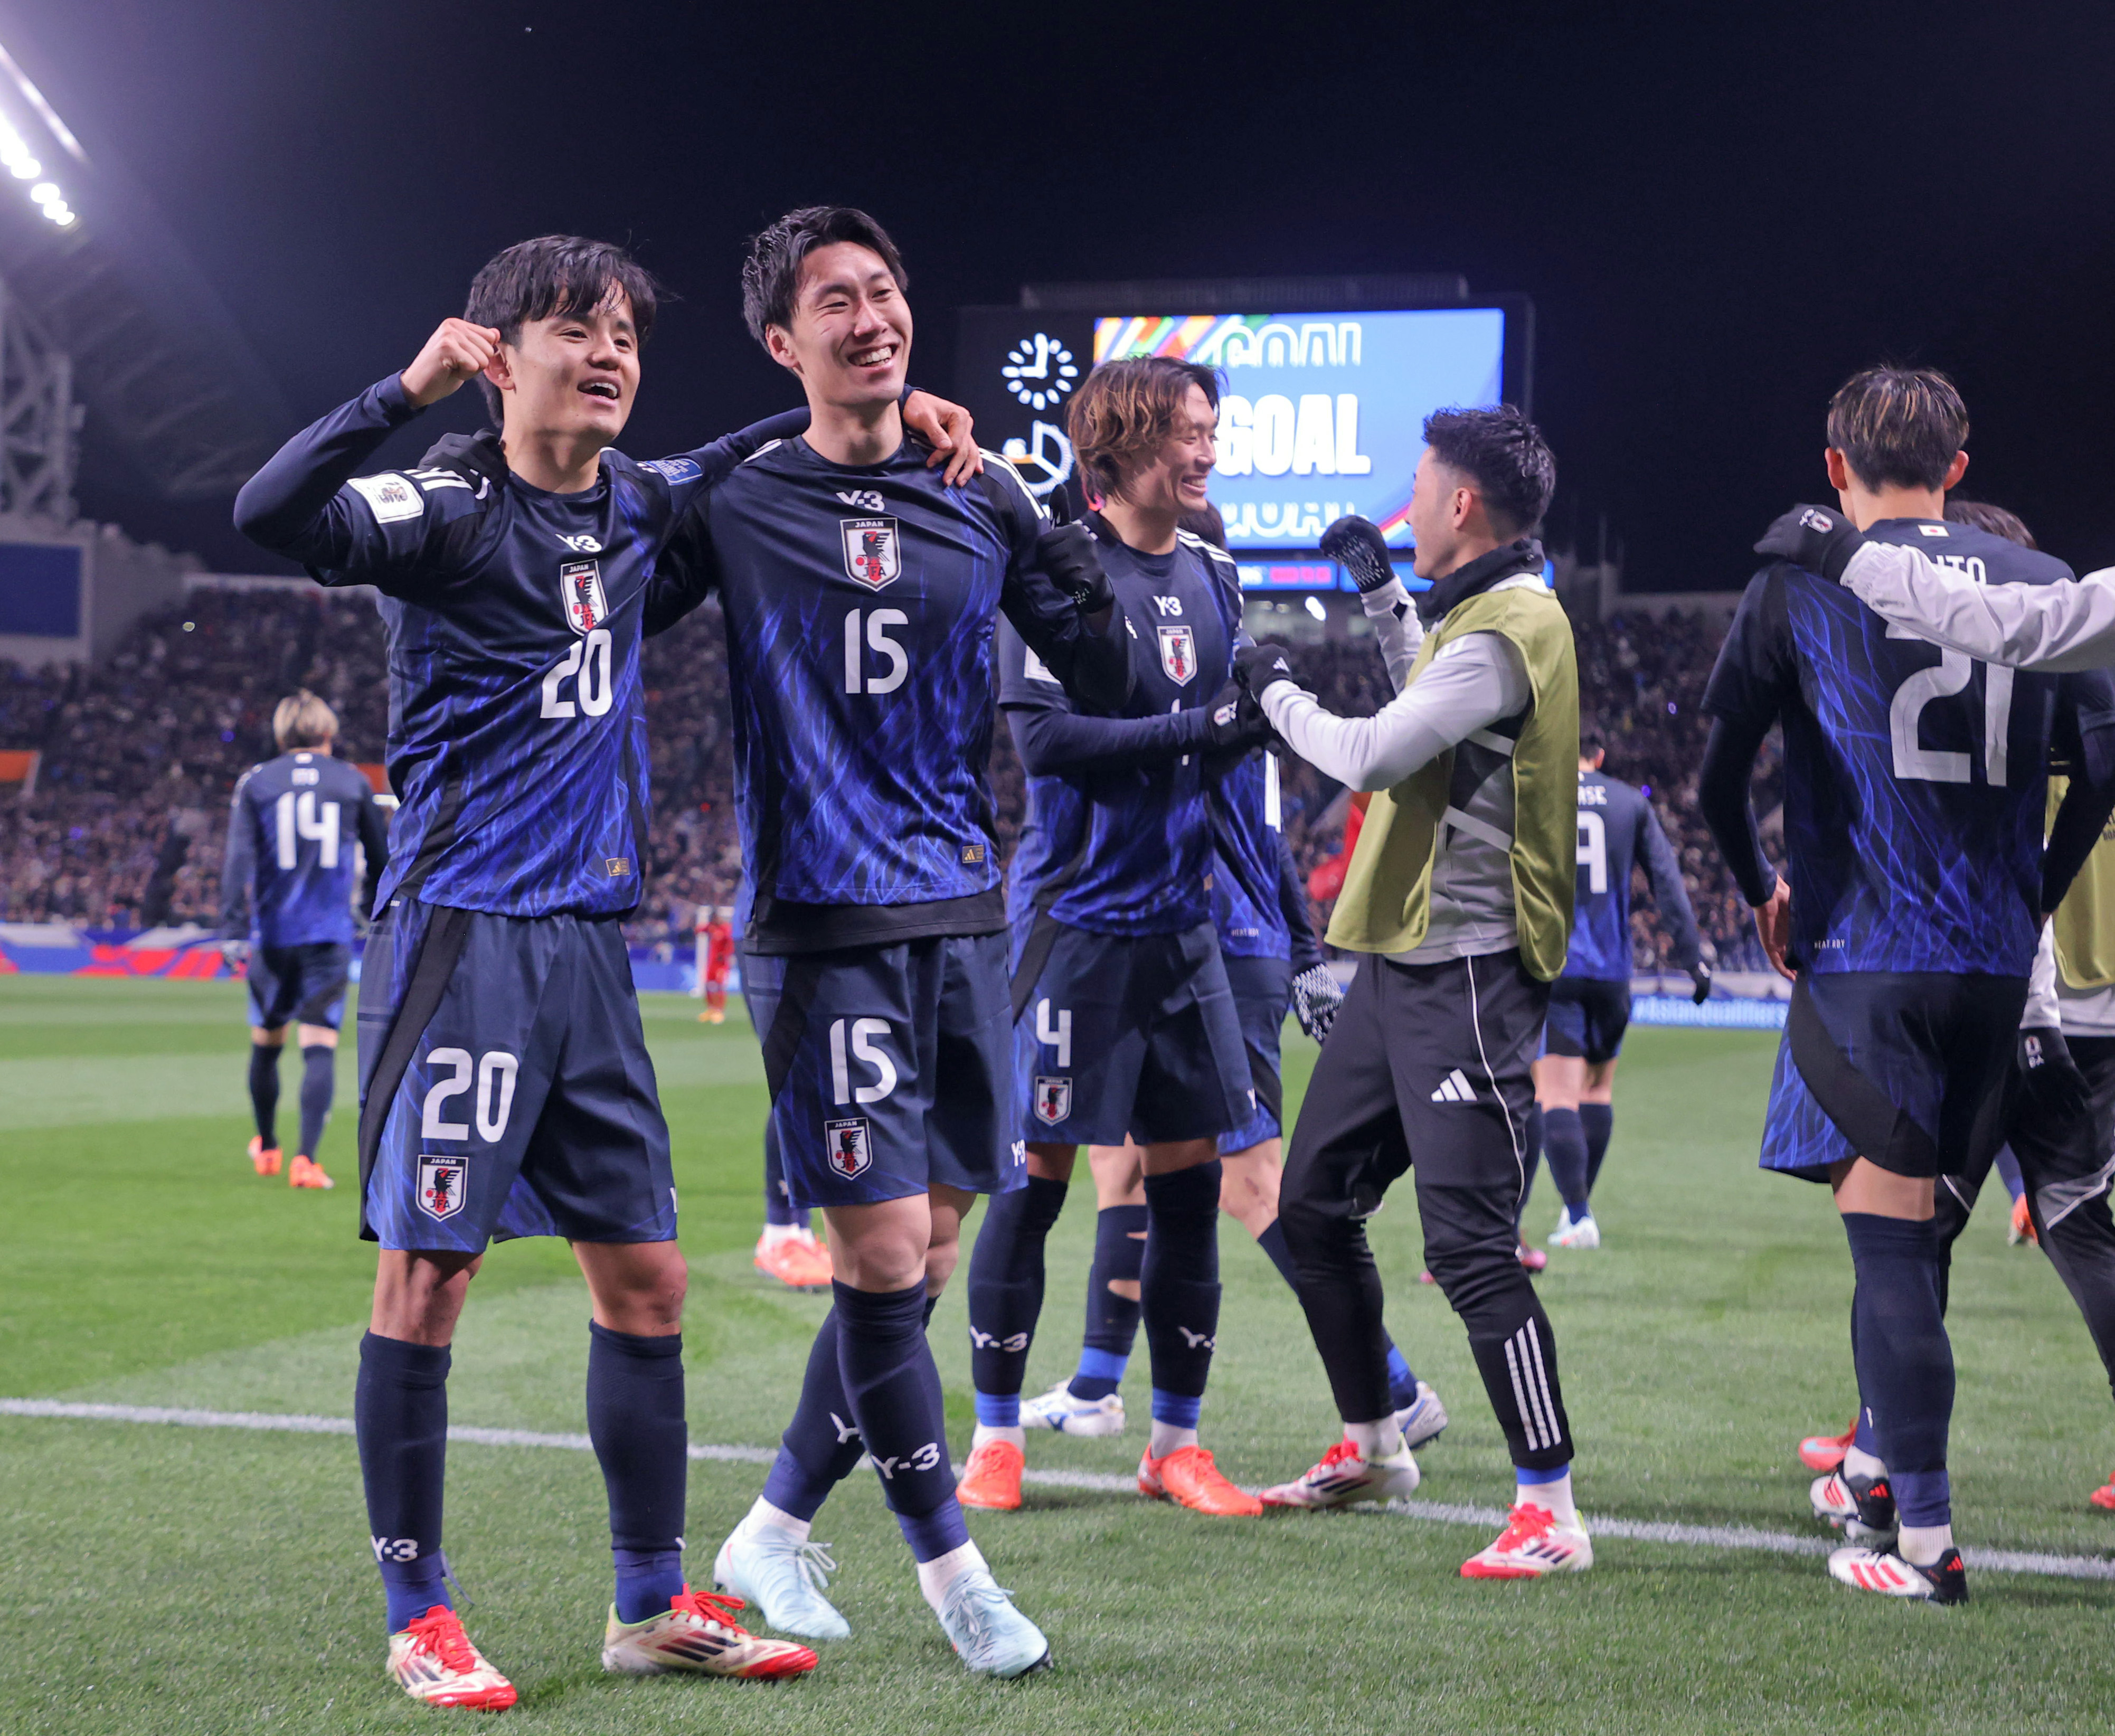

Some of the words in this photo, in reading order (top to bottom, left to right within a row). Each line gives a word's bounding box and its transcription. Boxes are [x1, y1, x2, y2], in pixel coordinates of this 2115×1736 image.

[1213, 393, 1371, 475] GOAL
[836, 490, 885, 512] Y-3
[555, 532, 602, 553] Y-3
[569, 564, 589, 573] JAPAN
[863, 566, 887, 577] JFA
[580, 612, 598, 627] JFA
[1153, 596, 1183, 617] Y-3
[844, 608, 909, 694] 15
[540, 629, 613, 719] 20
[1885, 624, 2015, 787] 21
[276, 790, 341, 871] 14
[1035, 997, 1072, 1068] 4
[829, 1017, 898, 1105] 15
[421, 1047, 520, 1143] 20
[841, 1160, 860, 1168] JFA
[1011, 1139, 1026, 1167] Y-3
[430, 1199, 451, 1209] JFA
[969, 1325, 1028, 1353] Y-3
[871, 1442, 941, 1480] Y-3
[370, 1535, 419, 1562] Y-3
